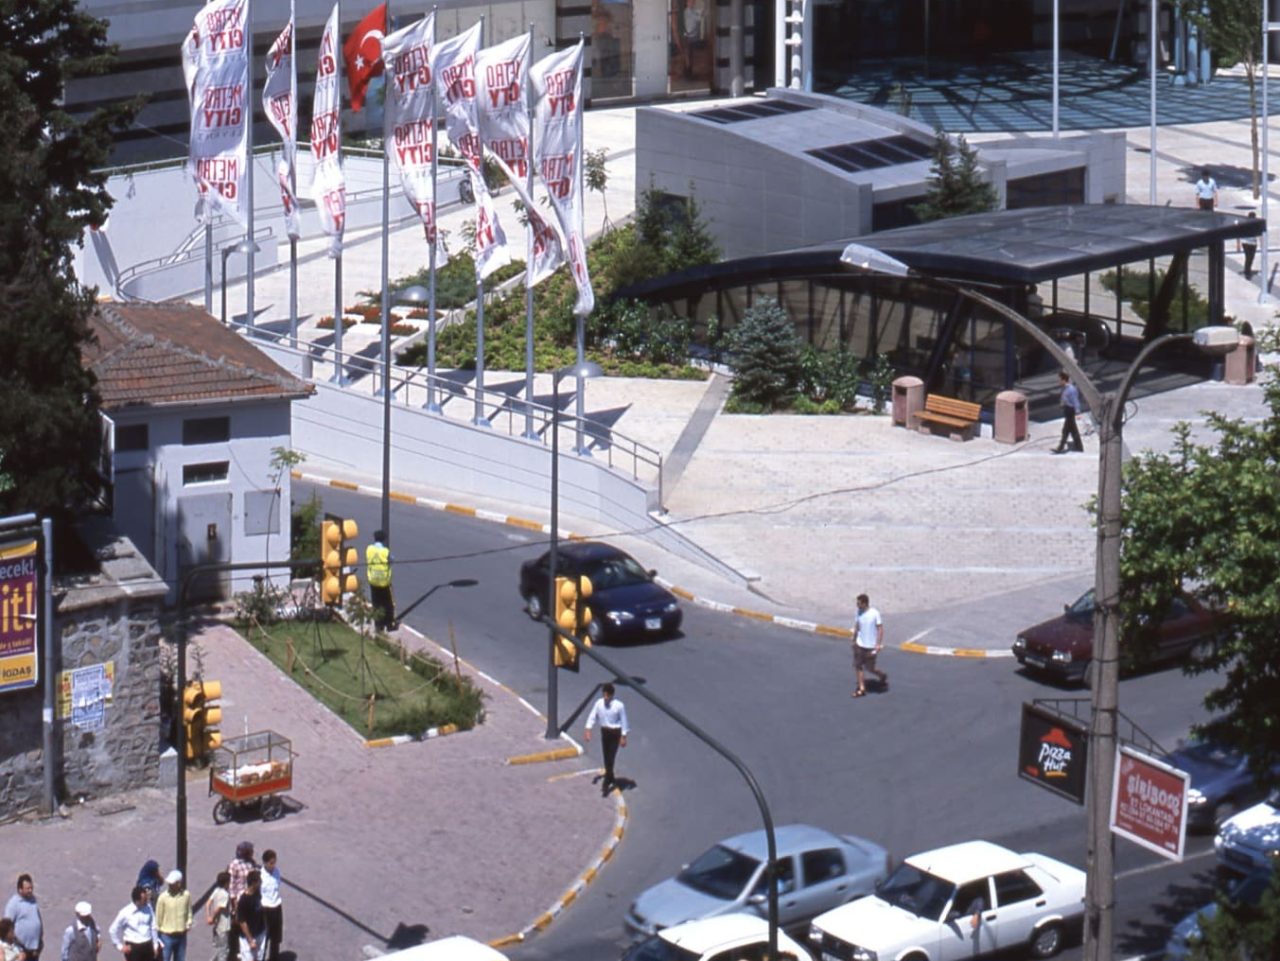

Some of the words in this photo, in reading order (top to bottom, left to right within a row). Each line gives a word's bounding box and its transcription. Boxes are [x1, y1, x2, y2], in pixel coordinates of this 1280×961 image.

[2, 581, 34, 633] it!
[1038, 742, 1072, 762] Pizza
[1042, 758, 1068, 772] Hut
